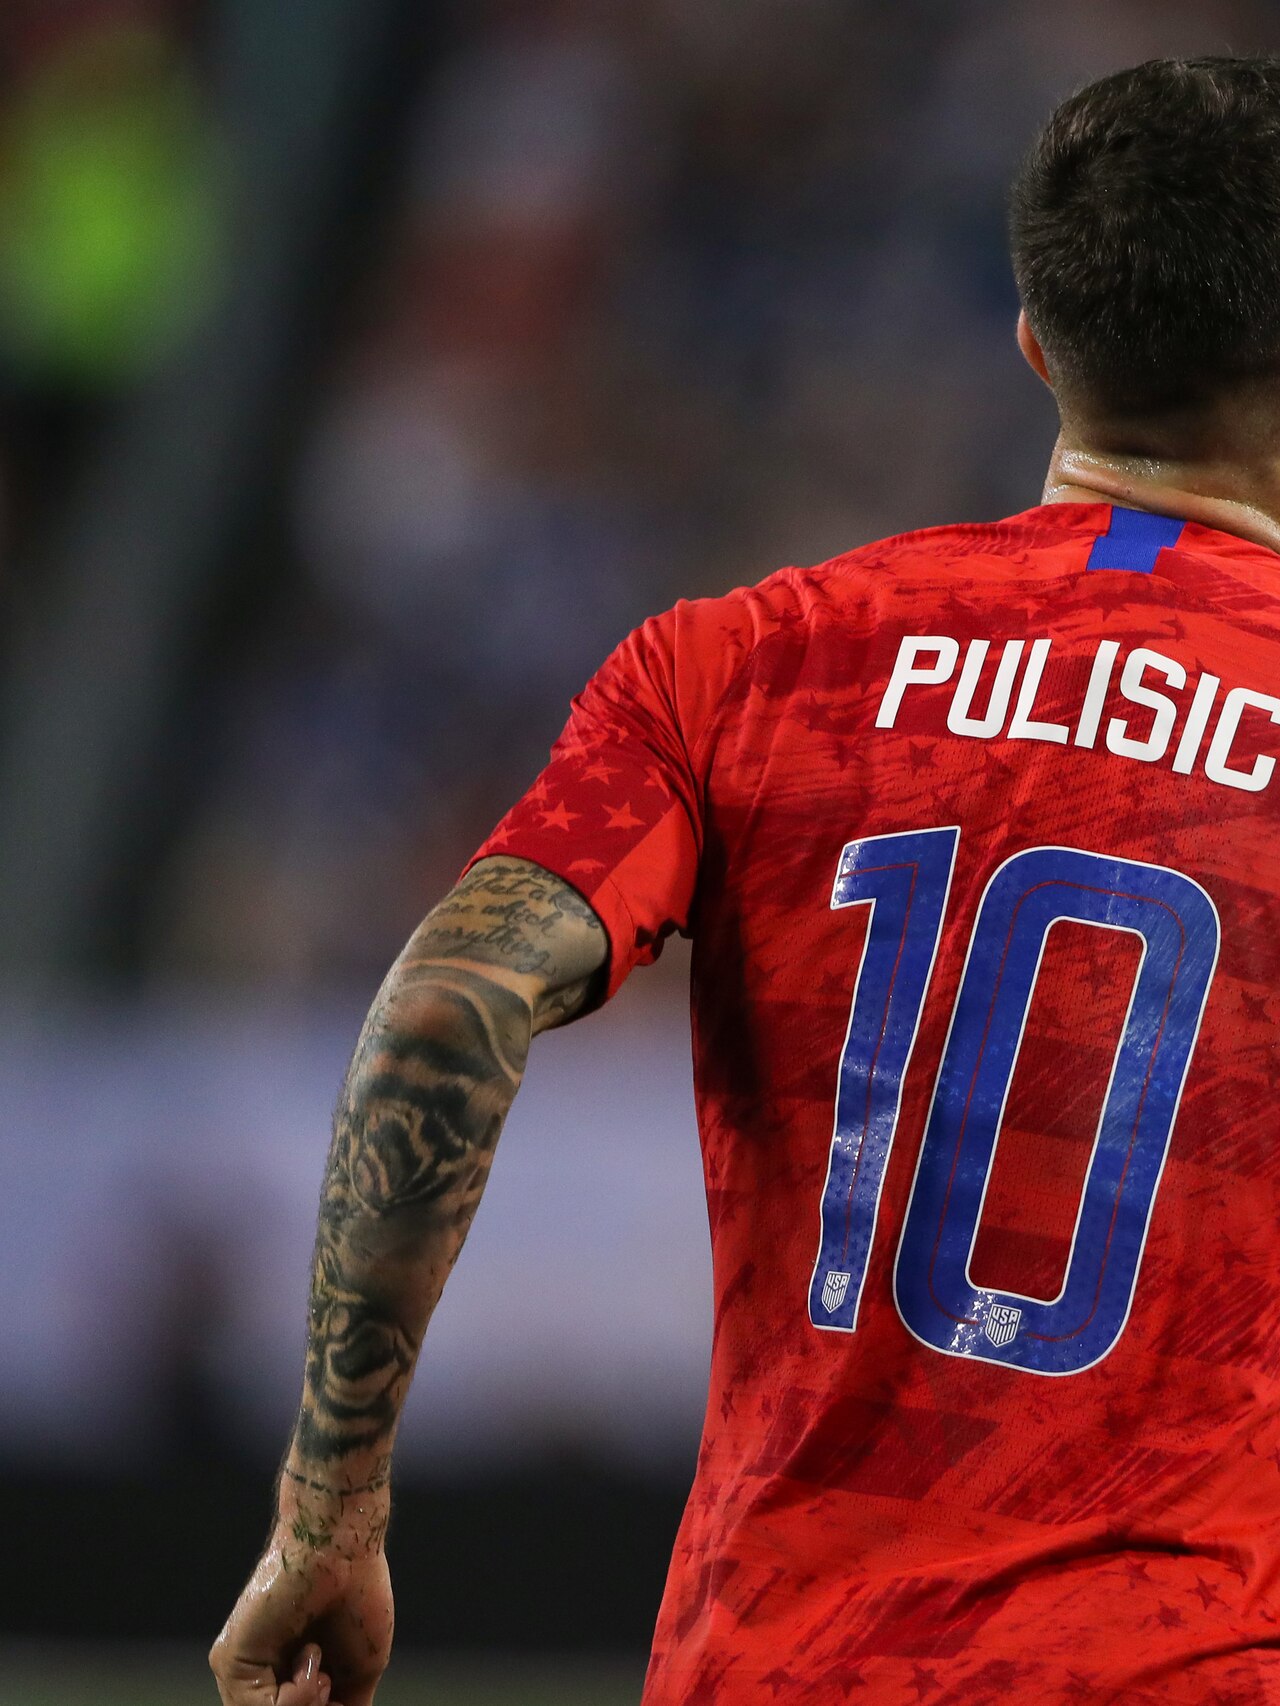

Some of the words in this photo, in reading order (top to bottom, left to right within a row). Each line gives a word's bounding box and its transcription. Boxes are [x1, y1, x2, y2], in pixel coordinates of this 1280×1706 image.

[808, 826, 1221, 1377] 10
[827, 1273, 848, 1290] USA
[992, 1306, 1019, 1325] USA
